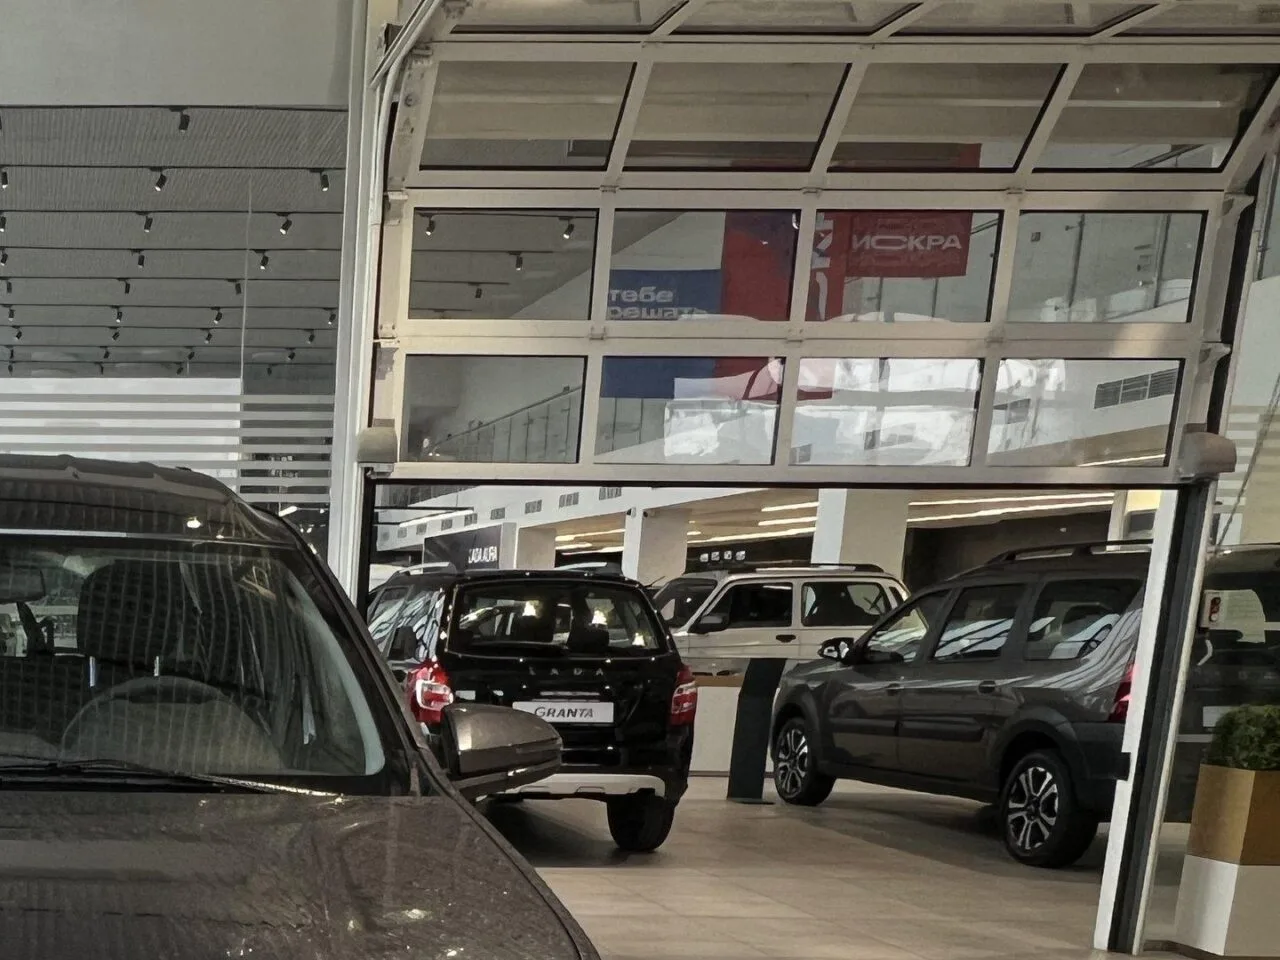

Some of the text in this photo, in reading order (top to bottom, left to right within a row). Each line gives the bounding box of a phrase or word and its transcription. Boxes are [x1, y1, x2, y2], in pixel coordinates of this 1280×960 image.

[852, 234, 962, 251] ИСКРА
[609, 286, 674, 303] тебе
[528, 666, 604, 676] LADA
[534, 706, 595, 719] GRANTA
